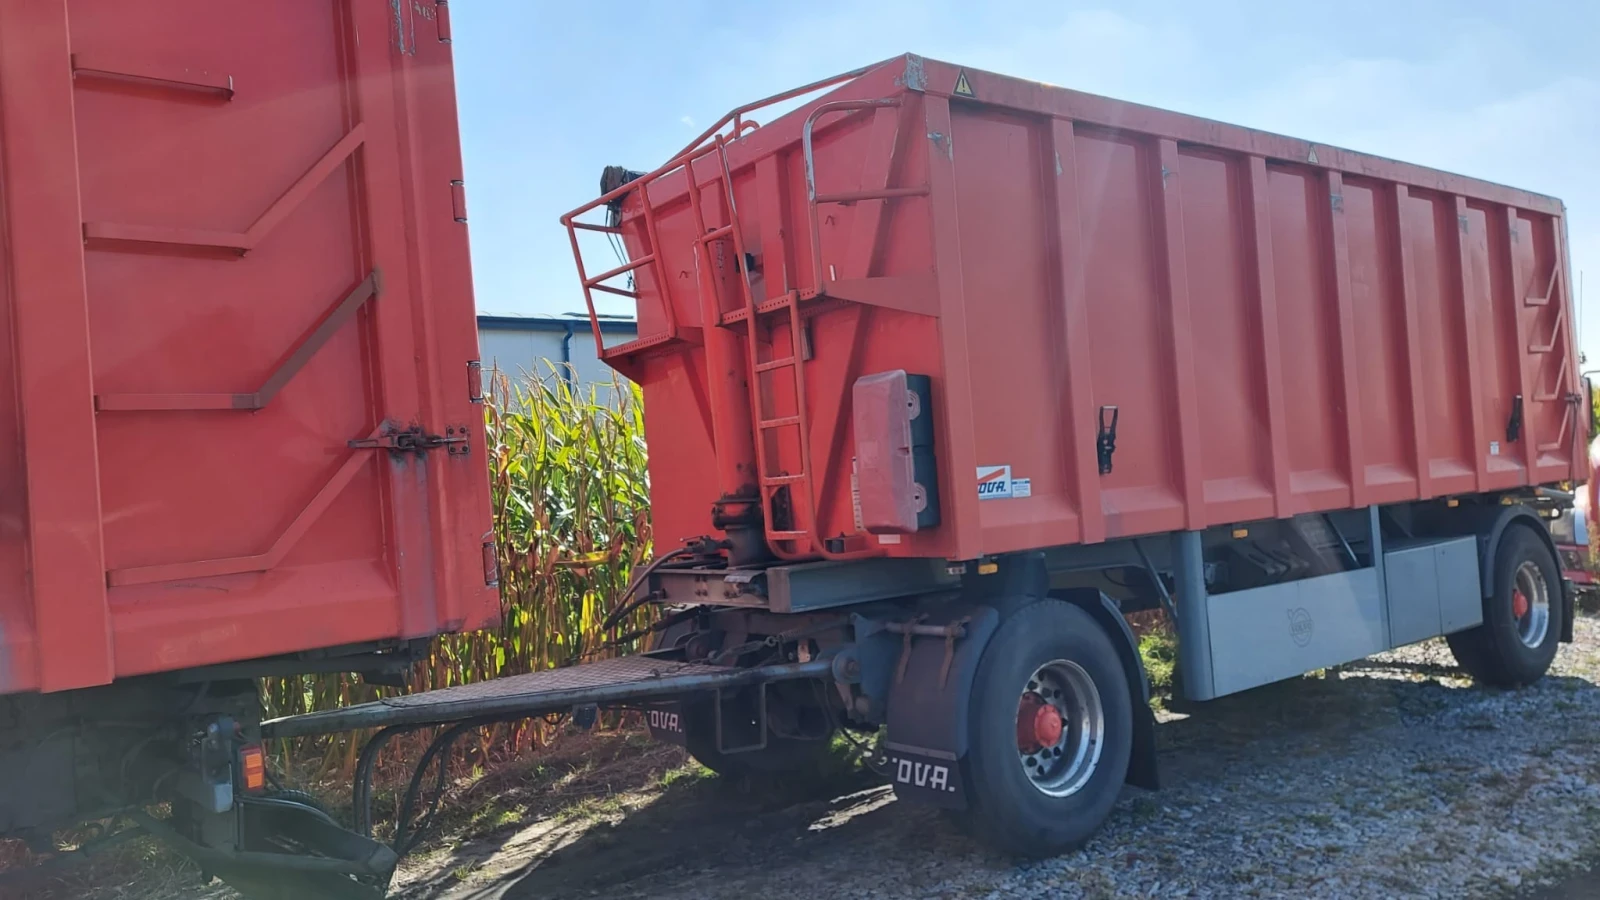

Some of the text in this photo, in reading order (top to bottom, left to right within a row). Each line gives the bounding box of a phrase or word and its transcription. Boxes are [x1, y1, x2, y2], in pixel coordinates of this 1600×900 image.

[978, 481, 1006, 493] OVA.
[646, 710, 682, 733] OVA.
[892, 757, 955, 792] OVA.
